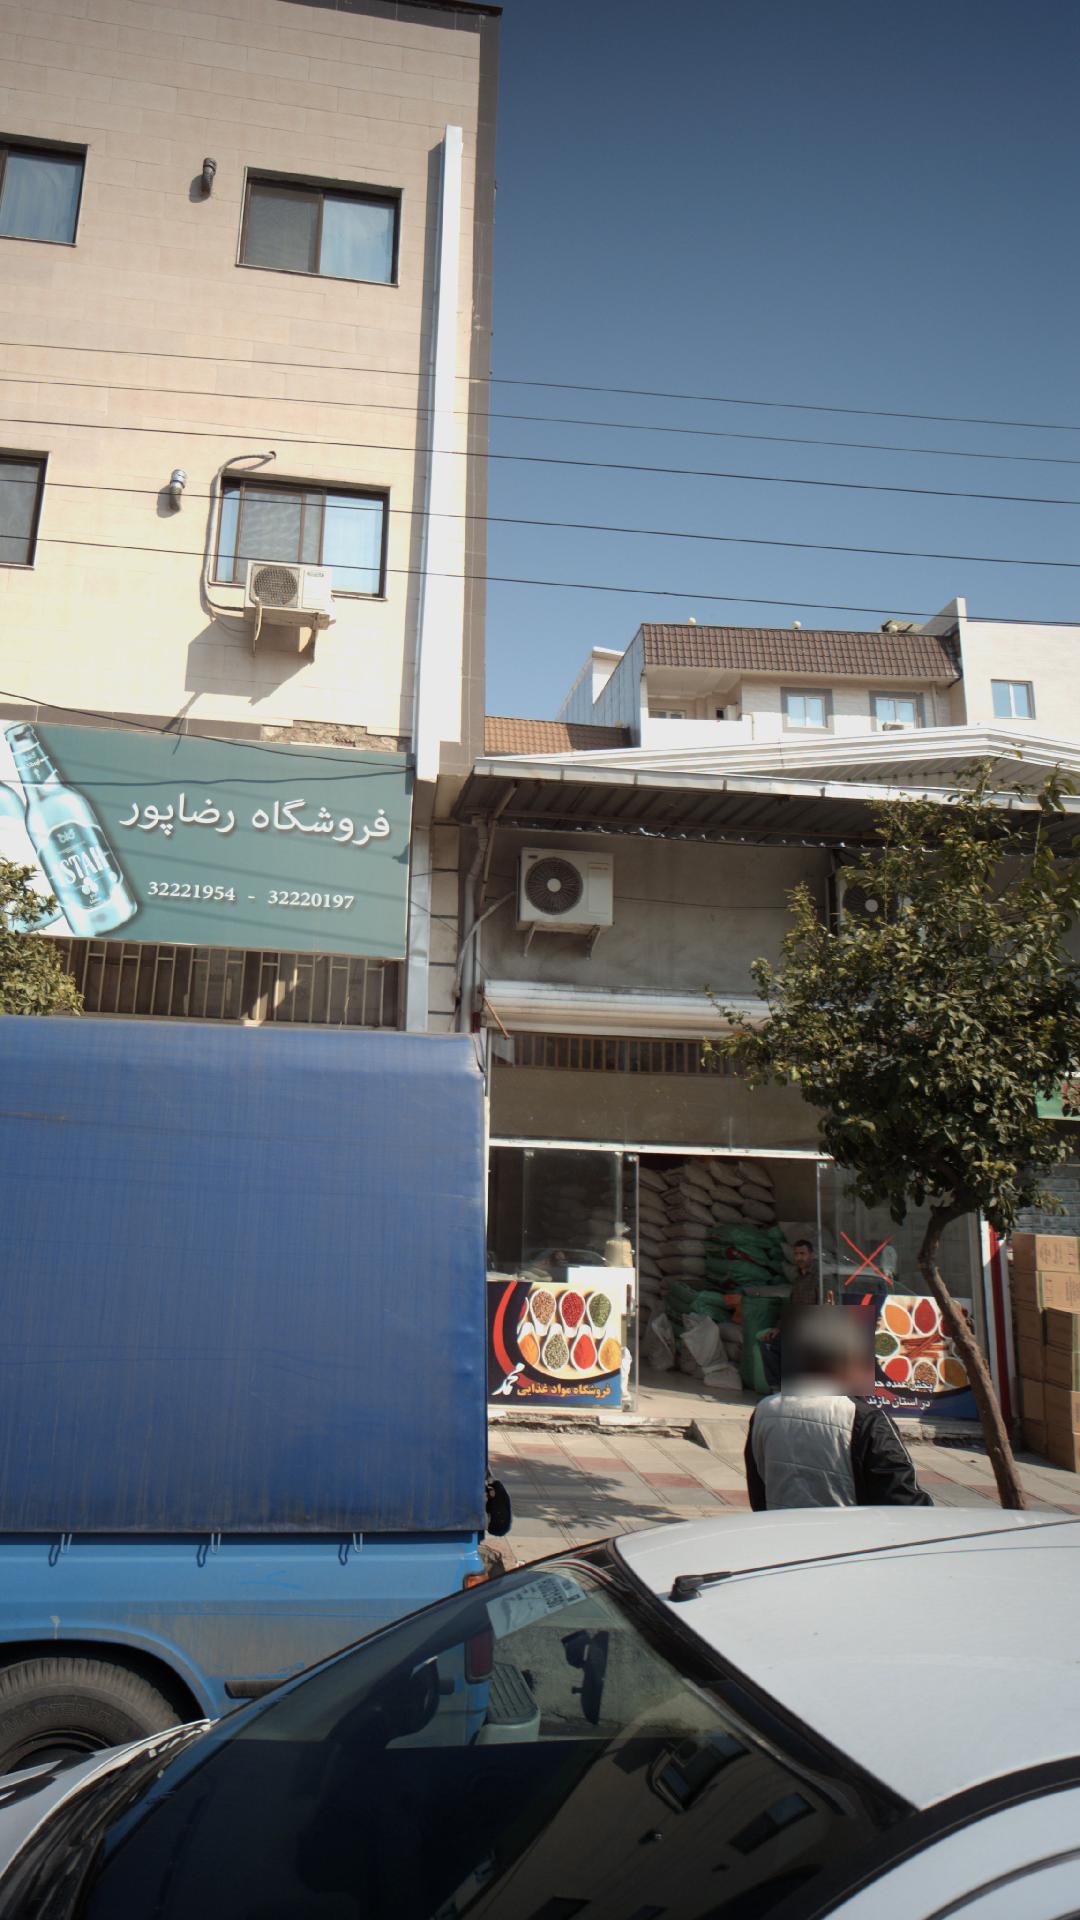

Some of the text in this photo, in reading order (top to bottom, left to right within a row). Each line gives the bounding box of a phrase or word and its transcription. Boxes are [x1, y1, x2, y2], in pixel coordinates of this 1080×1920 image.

[119, 792, 391, 846] فروشگاه رضاپور
[147, 881, 236, 902] 32221954
[267, 890, 355, 909] 32220197
[551, 1384, 572, 1398] مواد
[892, 1397, 918, 1408] استان
[920, 1399, 931, 1410] در
